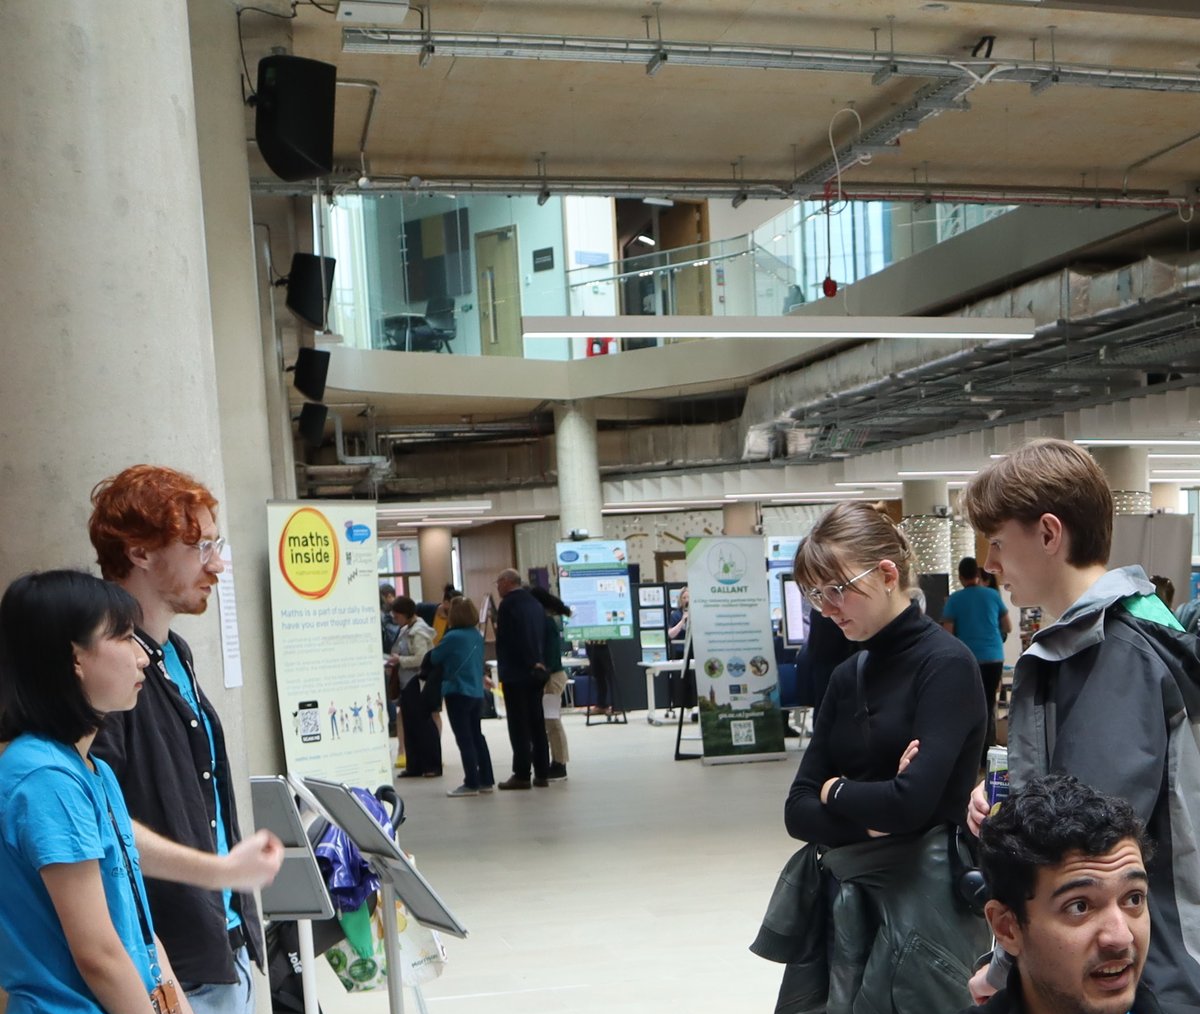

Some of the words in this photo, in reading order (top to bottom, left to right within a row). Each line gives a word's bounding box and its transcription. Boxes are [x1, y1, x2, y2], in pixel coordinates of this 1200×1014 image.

[288, 531, 330, 547] maths
[290, 547, 330, 564] inside
[710, 586, 748, 594] GALLANT
[280, 608, 304, 617] Maths
[281, 621, 300, 630] have
[302, 621, 315, 630] you
